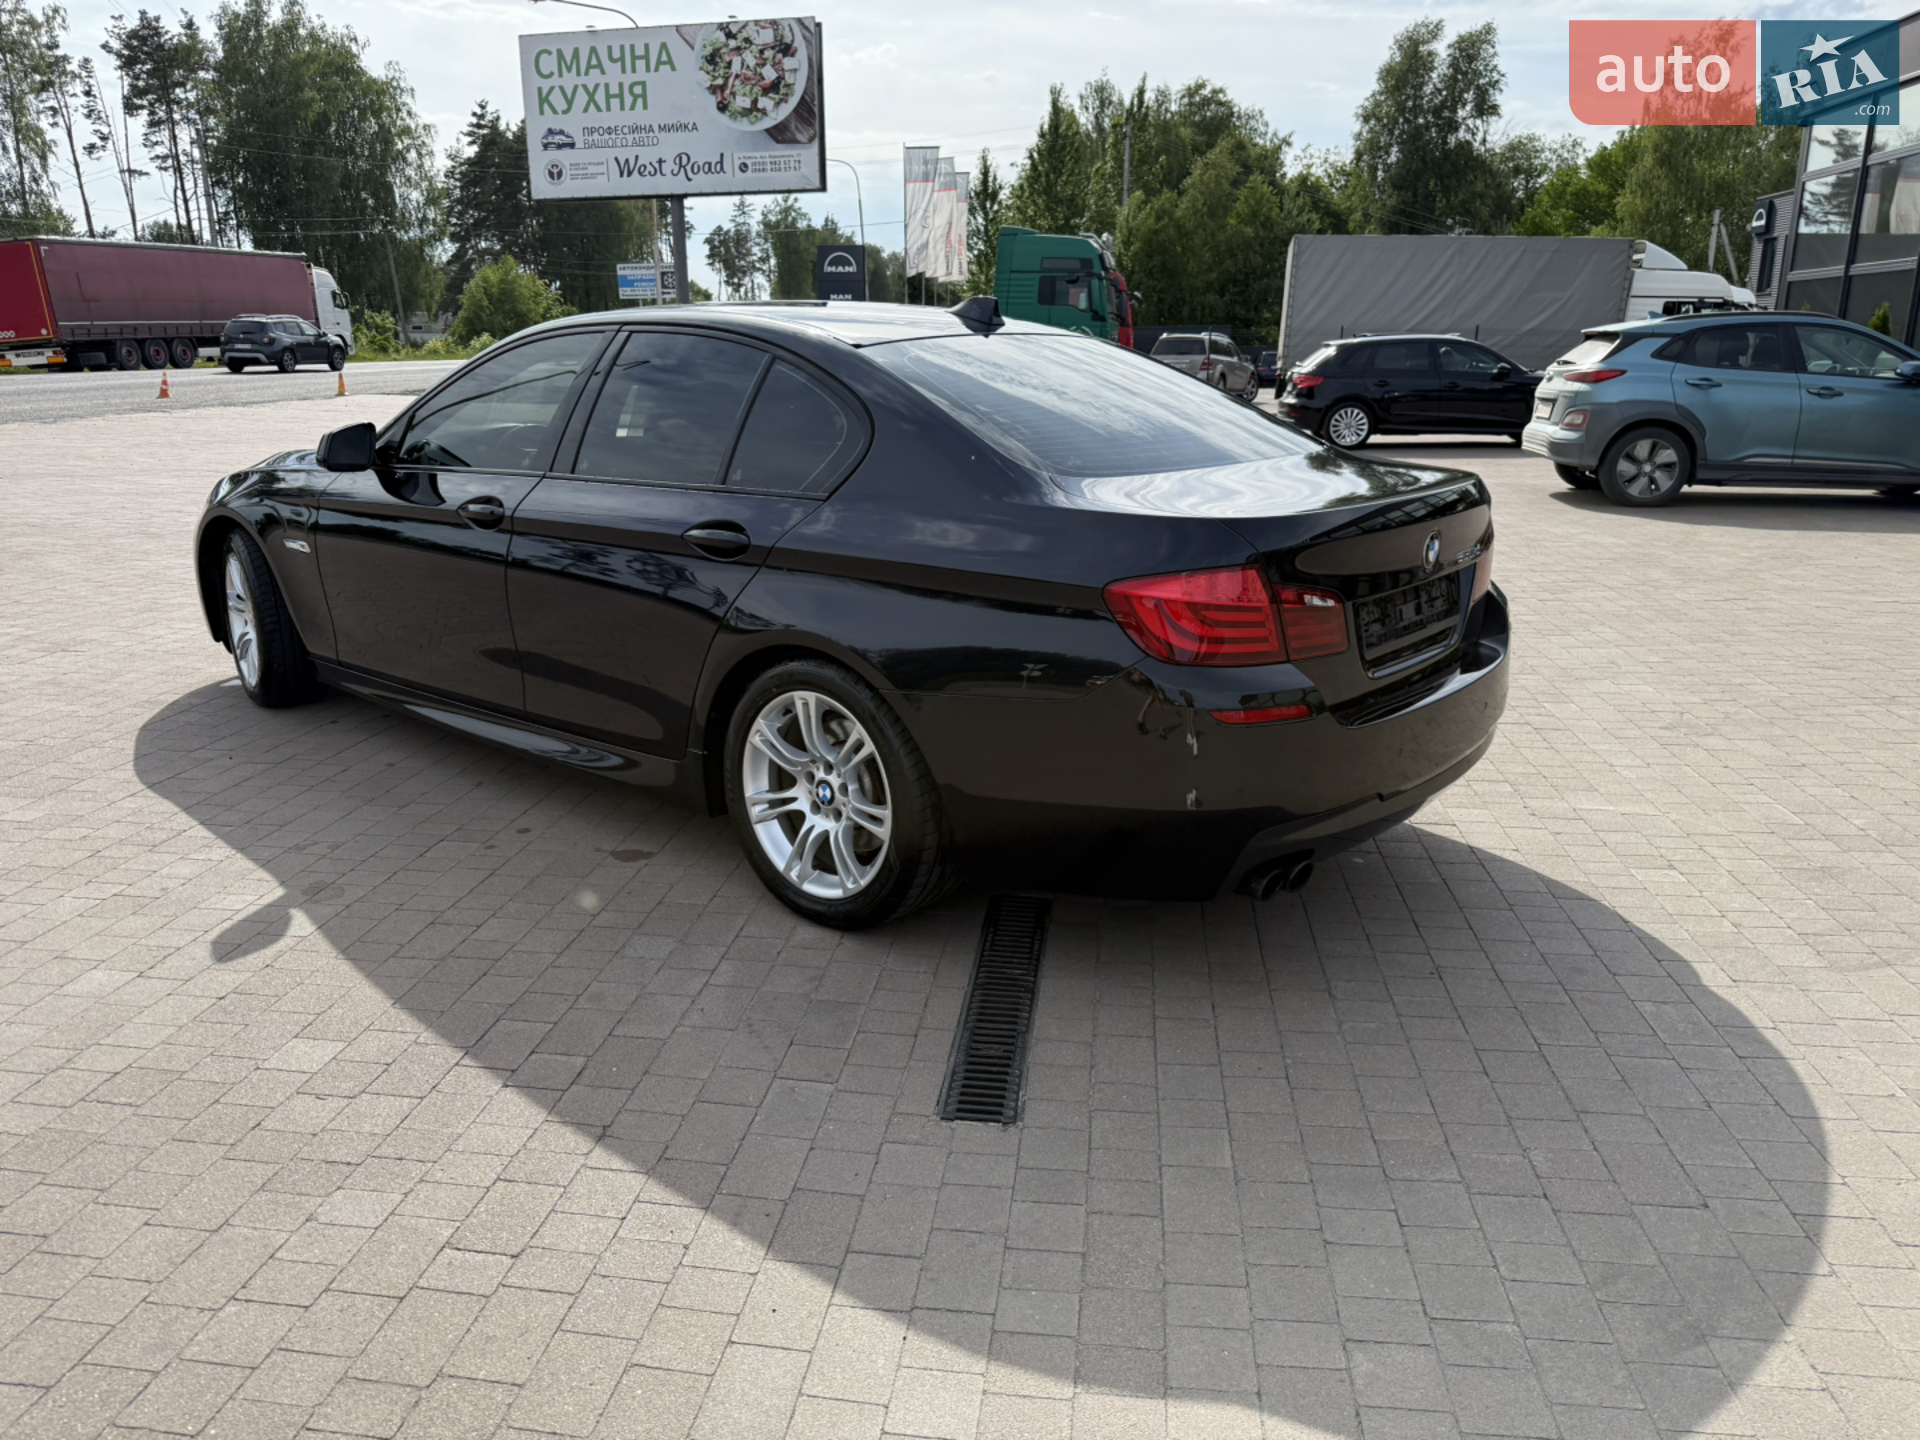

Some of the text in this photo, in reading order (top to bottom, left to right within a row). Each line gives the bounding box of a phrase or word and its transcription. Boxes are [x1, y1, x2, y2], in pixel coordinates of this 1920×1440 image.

[534, 41, 677, 79] СМАЧНА
[537, 80, 648, 116] КУХНЯ
[582, 121, 699, 137] ПРОФЕСІЙНА МИЙКА
[583, 135, 660, 149] ВАШОГО АВТО
[614, 152, 727, 182] West Road
